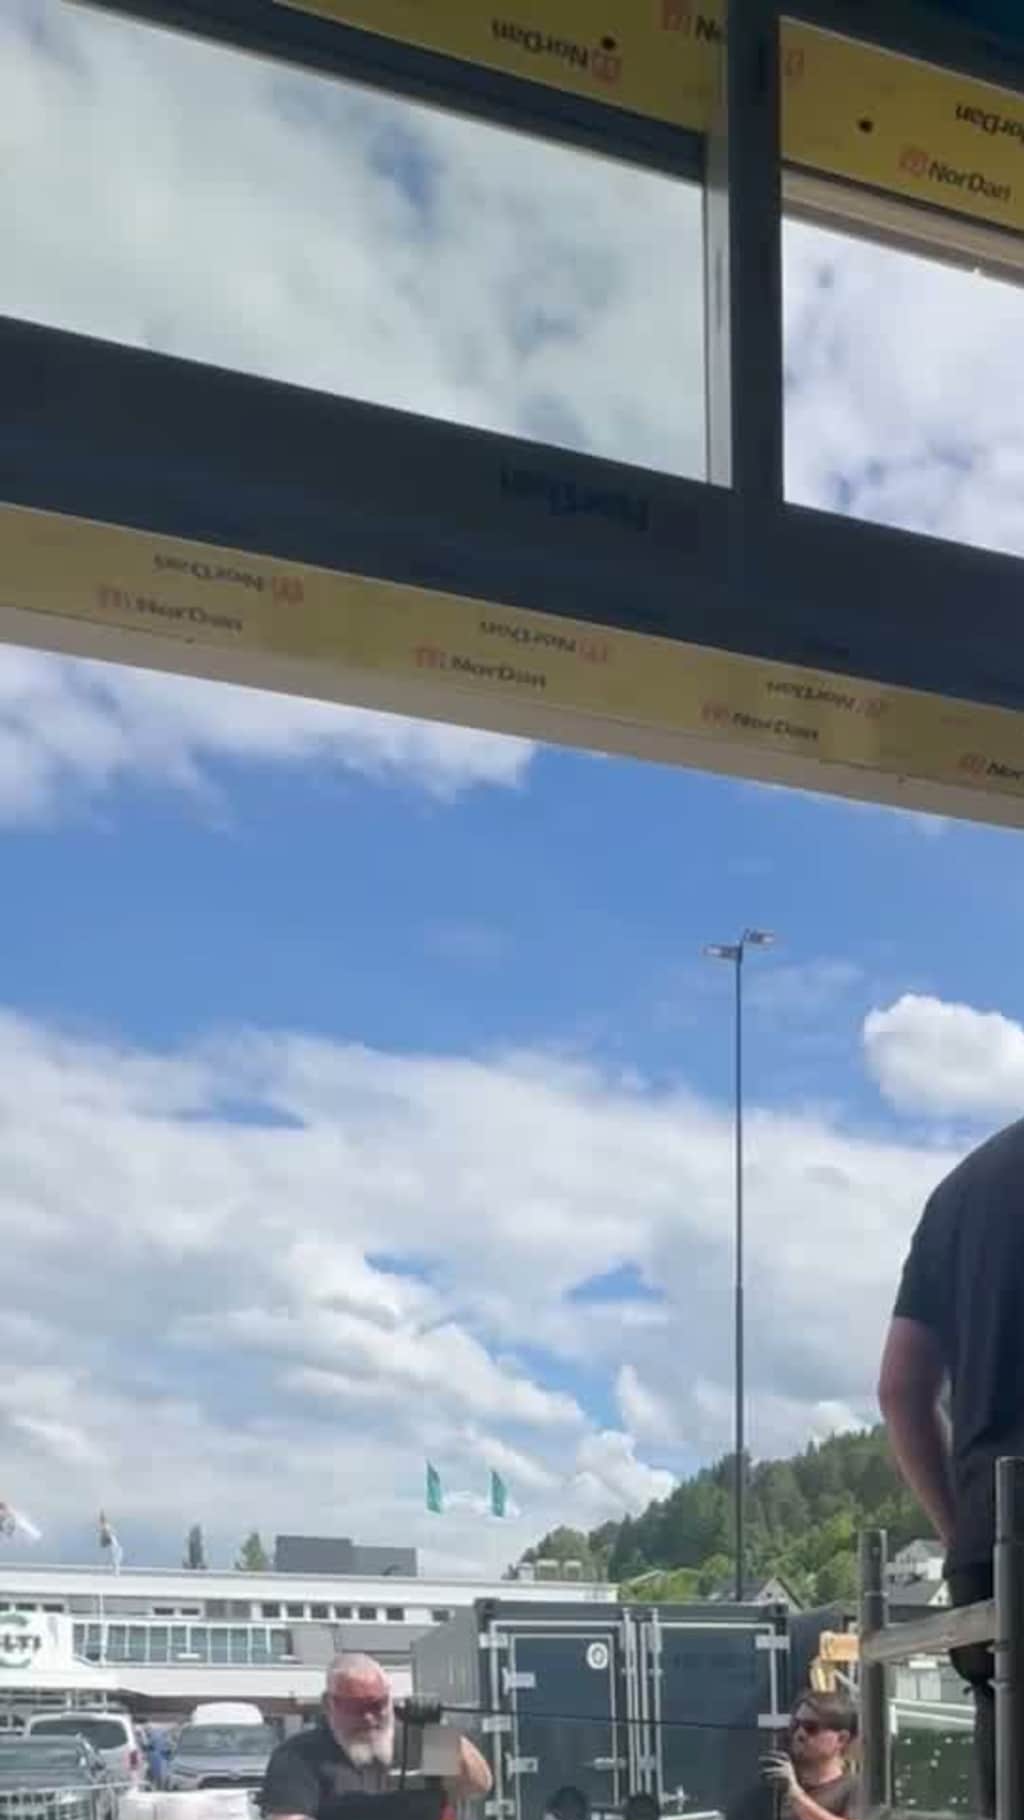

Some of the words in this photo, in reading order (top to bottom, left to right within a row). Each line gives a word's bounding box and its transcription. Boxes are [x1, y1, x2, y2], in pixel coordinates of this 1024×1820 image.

[491, 17, 590, 70] NorDan
[928, 160, 1011, 202] NorDan
[134, 594, 244, 634] NorDan
[450, 653, 548, 690] NorDan
